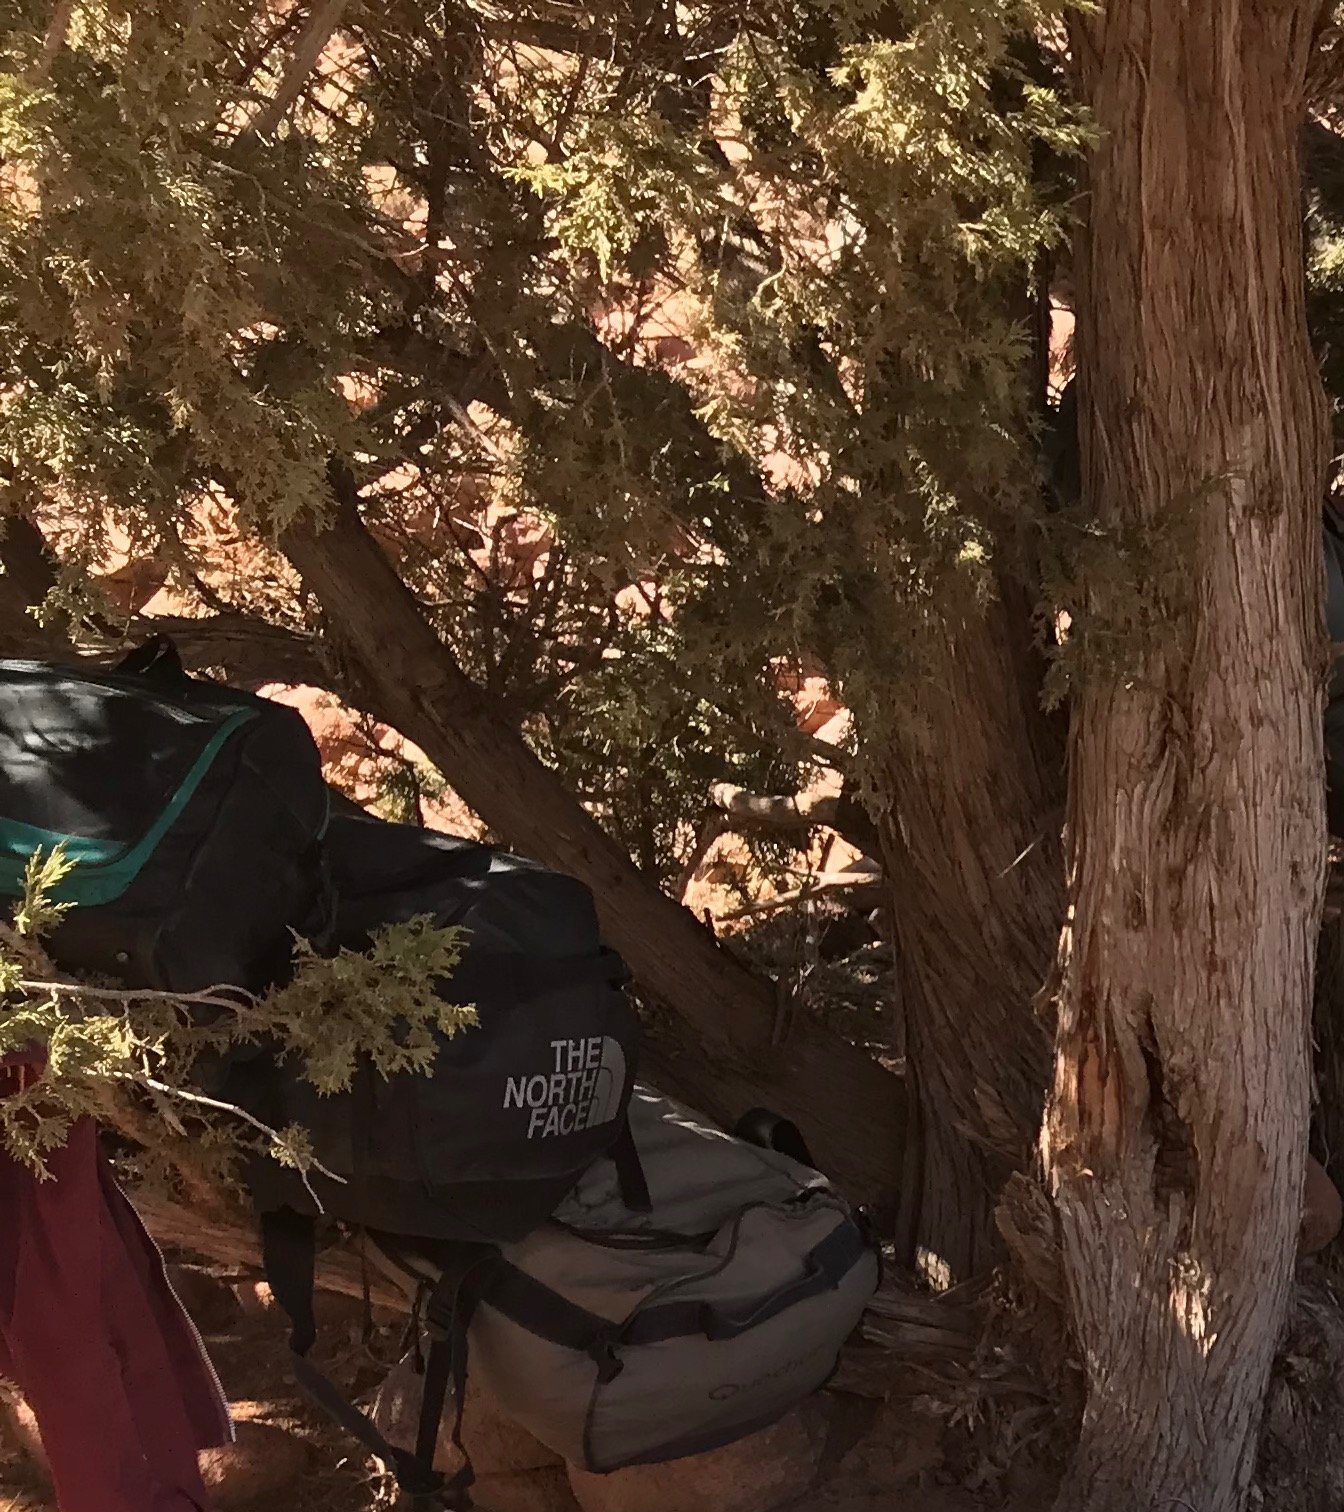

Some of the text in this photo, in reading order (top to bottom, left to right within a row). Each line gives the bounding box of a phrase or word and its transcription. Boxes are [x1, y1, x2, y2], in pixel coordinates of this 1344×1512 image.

[551, 1036, 601, 1072] THE
[503, 1068, 598, 1108] NORTH
[527, 1100, 592, 1139] FACE
